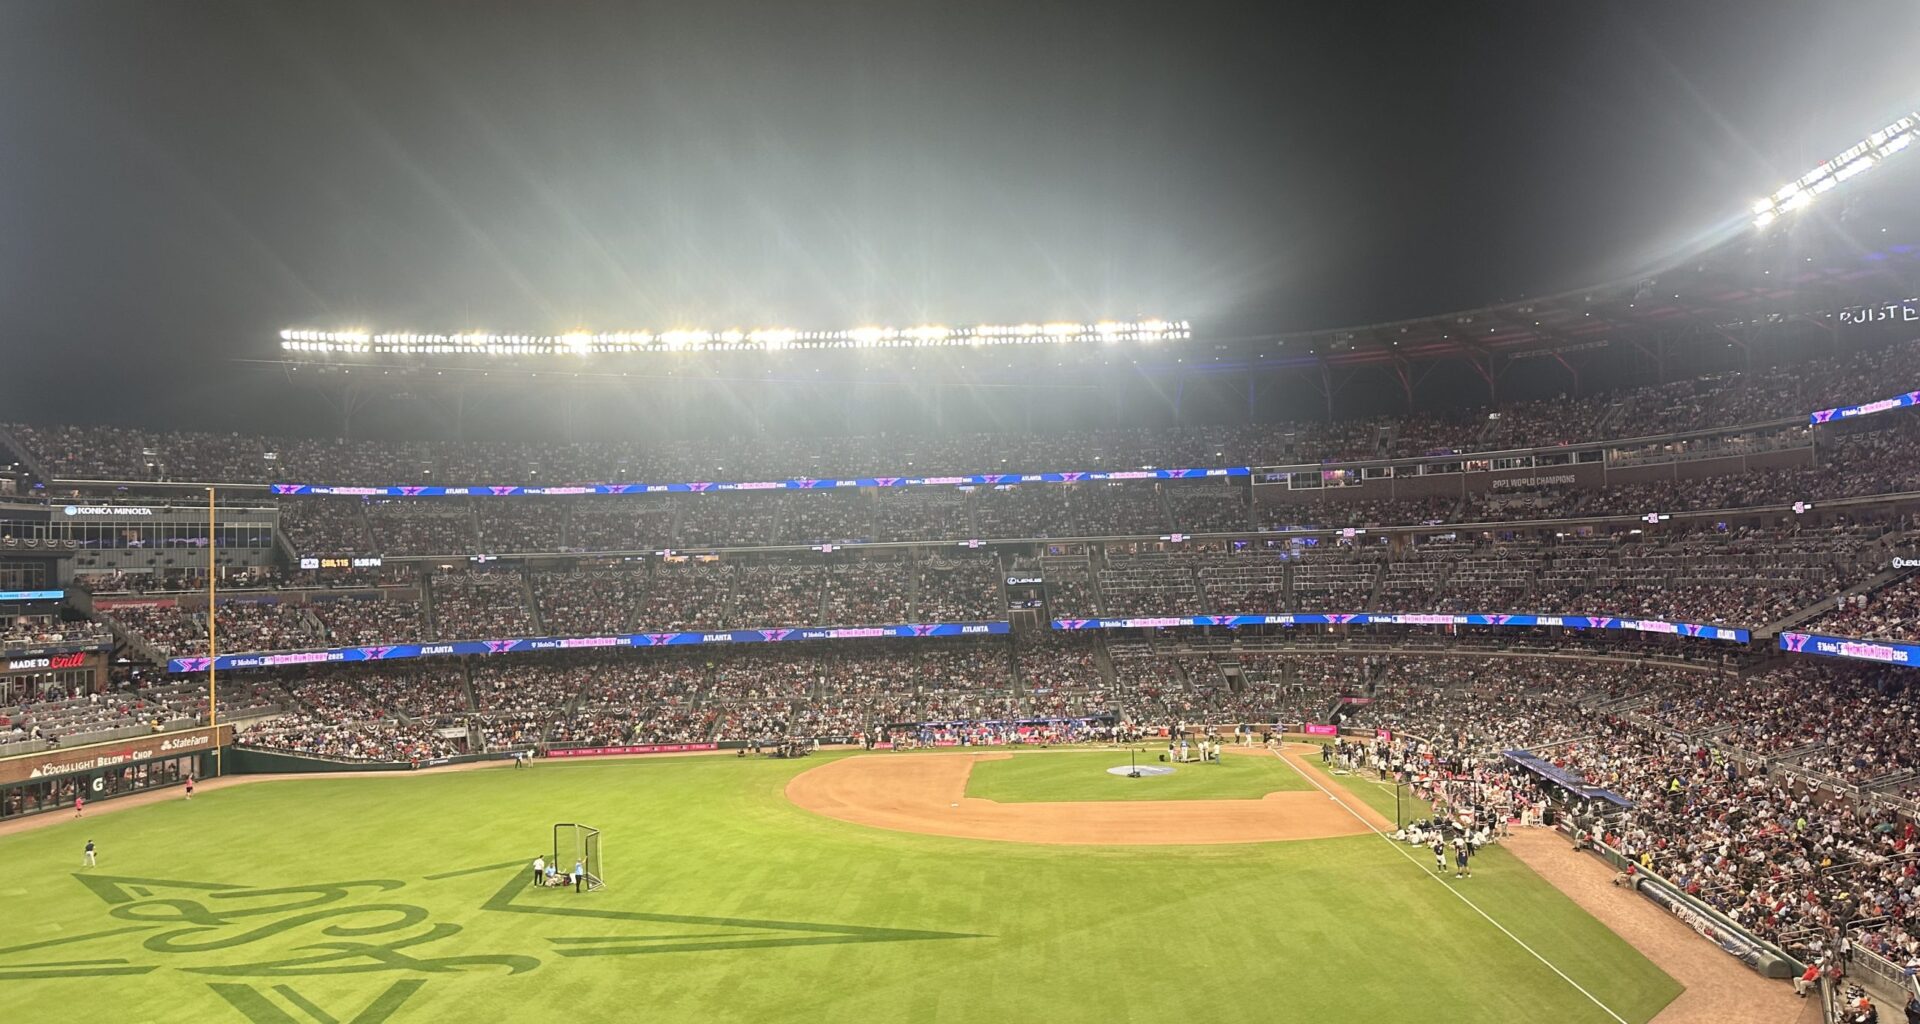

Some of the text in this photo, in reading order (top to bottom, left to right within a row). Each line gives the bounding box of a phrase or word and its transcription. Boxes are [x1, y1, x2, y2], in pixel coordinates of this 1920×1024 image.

[1536, 474, 1575, 486] CHAMPIONS
[77, 507, 153, 516] KONICA MINOLTA
[1264, 615, 1295, 624] ATLANTA
[1536, 617, 1564, 626] ATLANTA
[962, 625, 989, 633] ATLANTA
[703, 633, 732, 642] ATLANTA
[421, 645, 454, 655] ATLANTA
[9, 660, 36, 670] MADE
[37, 658, 50, 668] TO
[237, 658, 258, 666] Mobile
[42, 762, 69, 776] Coors
[69, 759, 95, 772] LIGHT
[92, 777, 104, 791] G
